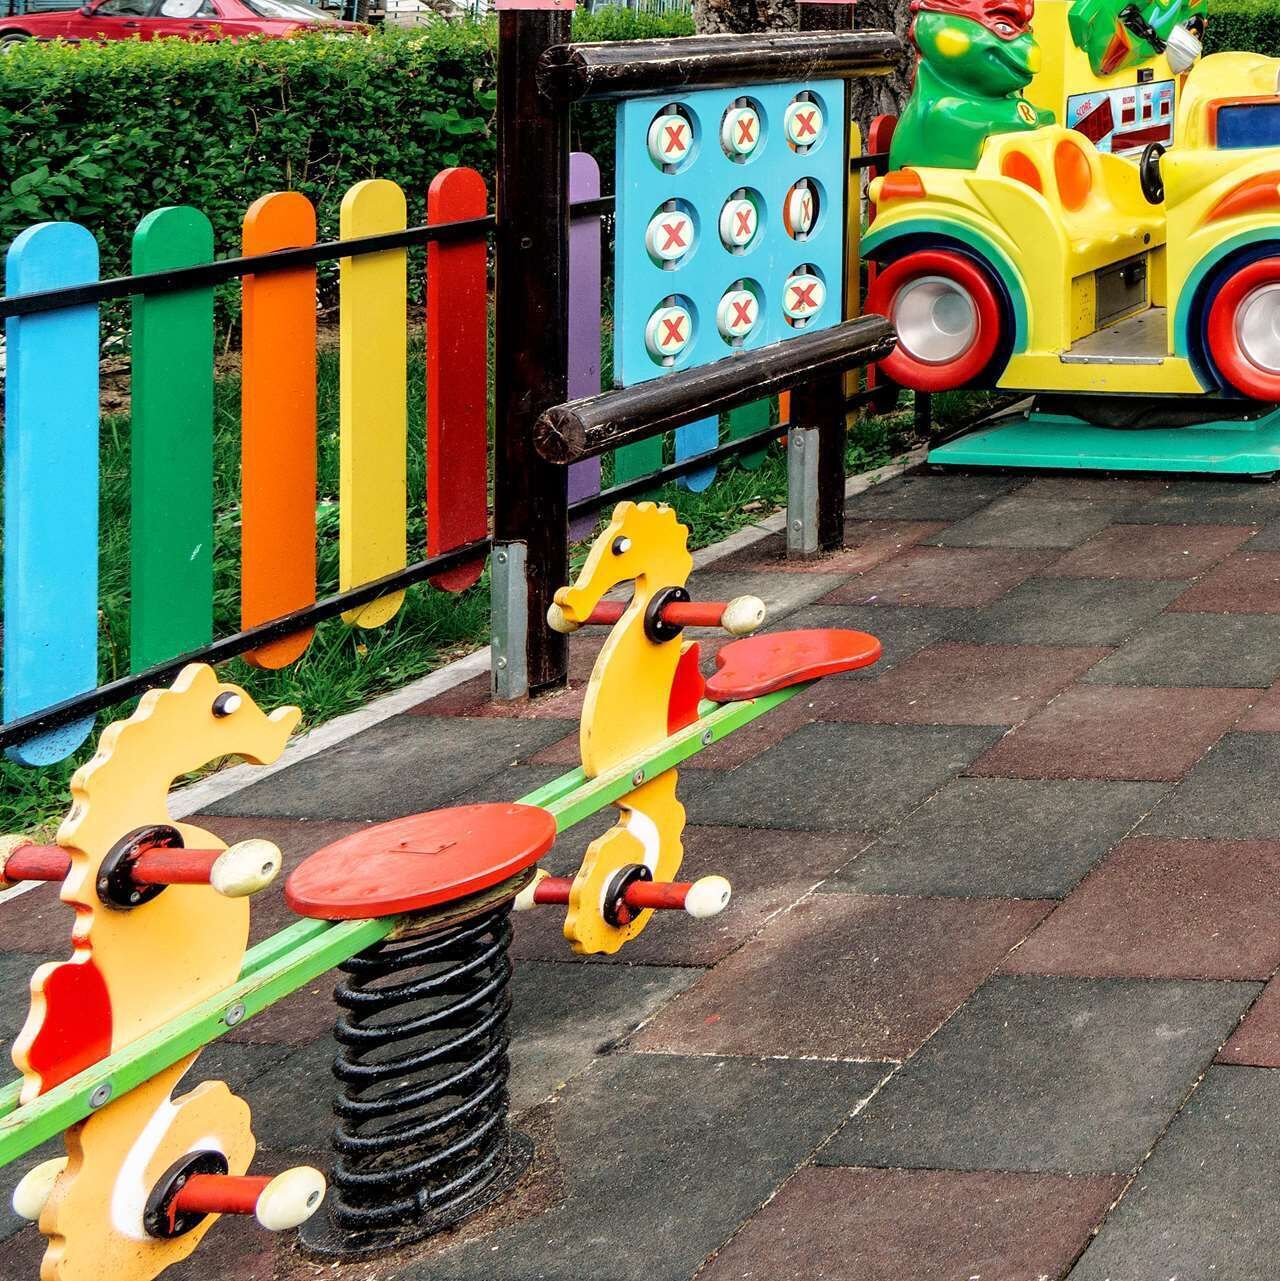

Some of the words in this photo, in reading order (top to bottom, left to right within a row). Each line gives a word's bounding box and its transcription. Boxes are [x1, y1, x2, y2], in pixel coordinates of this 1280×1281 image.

[1076, 99, 1092, 117] SCORE
[665, 124, 685, 153] X
[737, 118, 754, 144] X
[795, 111, 816, 138] X
[662, 220, 686, 251] X
[736, 209, 752, 236] X
[662, 315, 685, 346] X
[732, 299, 753, 327] X
[790, 283, 818, 311] X
